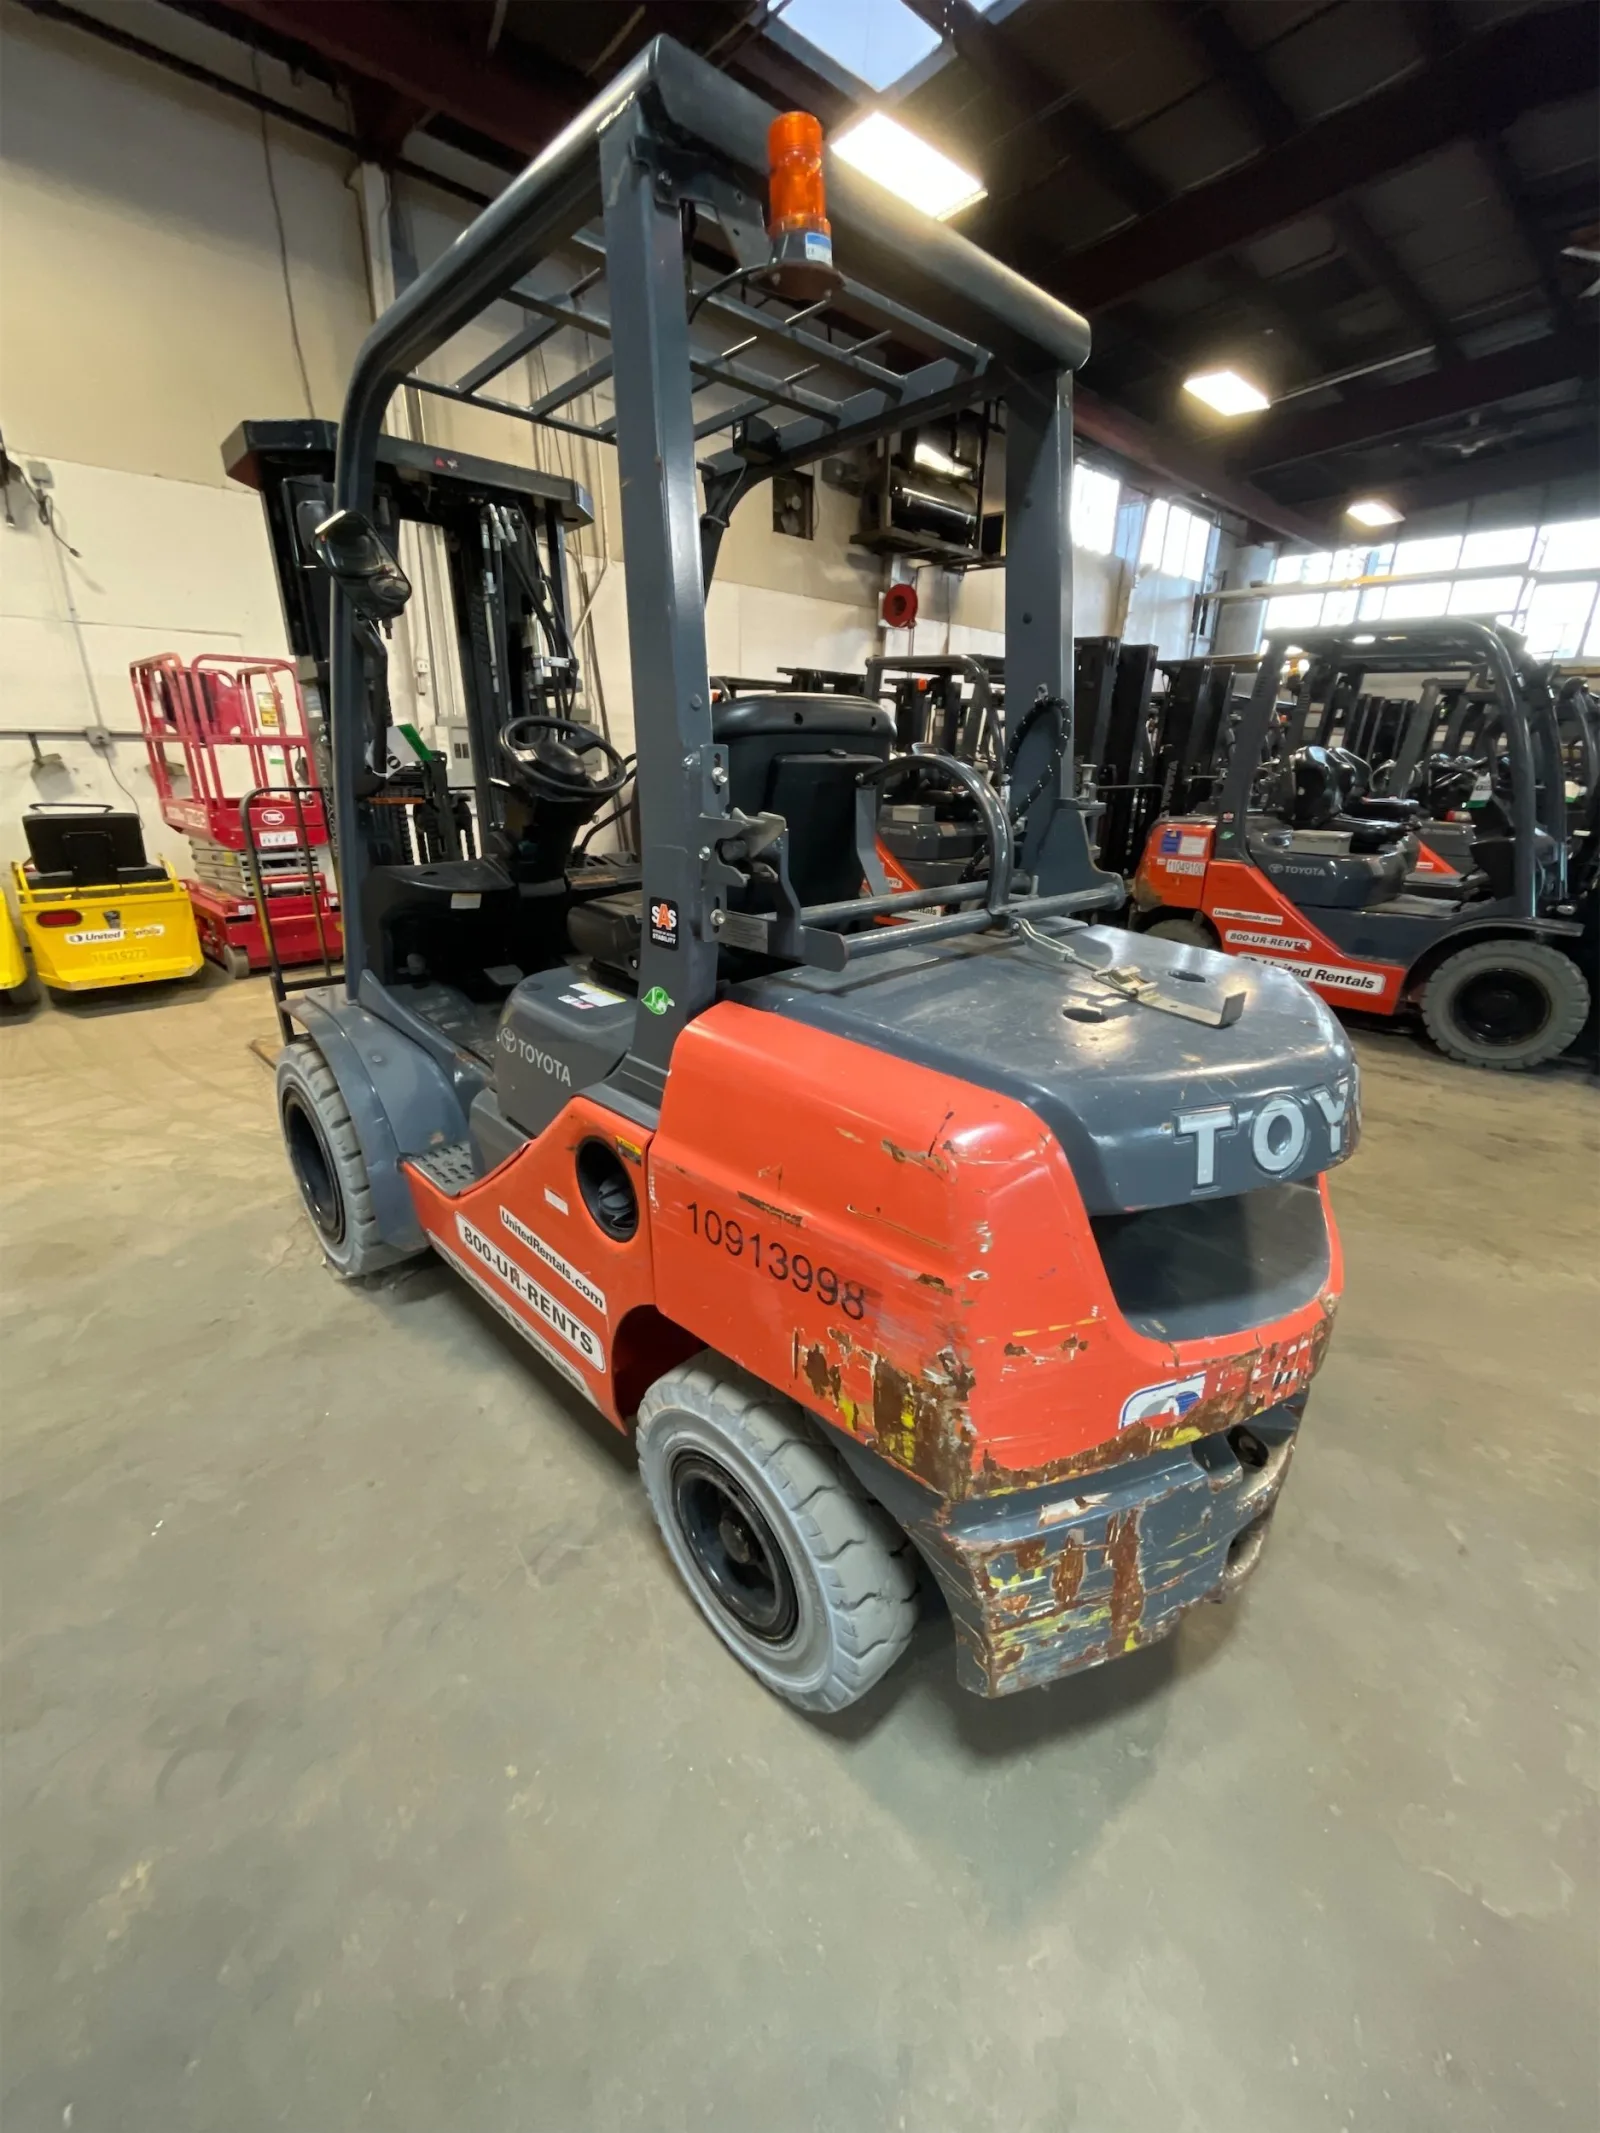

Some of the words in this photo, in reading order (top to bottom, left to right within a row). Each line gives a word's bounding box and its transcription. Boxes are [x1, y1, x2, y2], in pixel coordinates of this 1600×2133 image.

[1284, 865, 1326, 877] TOYOTA
[651, 903, 677, 931] SAS
[1213, 909, 1282, 924] UnitedRentals.com
[85, 931, 121, 942] United
[1314, 968, 1375, 990] Rentals
[518, 1038, 572, 1087] TOYOTA
[1176, 1065, 1361, 1187] TOY
[501, 1209, 604, 1309] UnitedRentals.com
[687, 1200, 864, 1321] 10913998
[463, 1226, 594, 1356] 800-UR-RENTS
